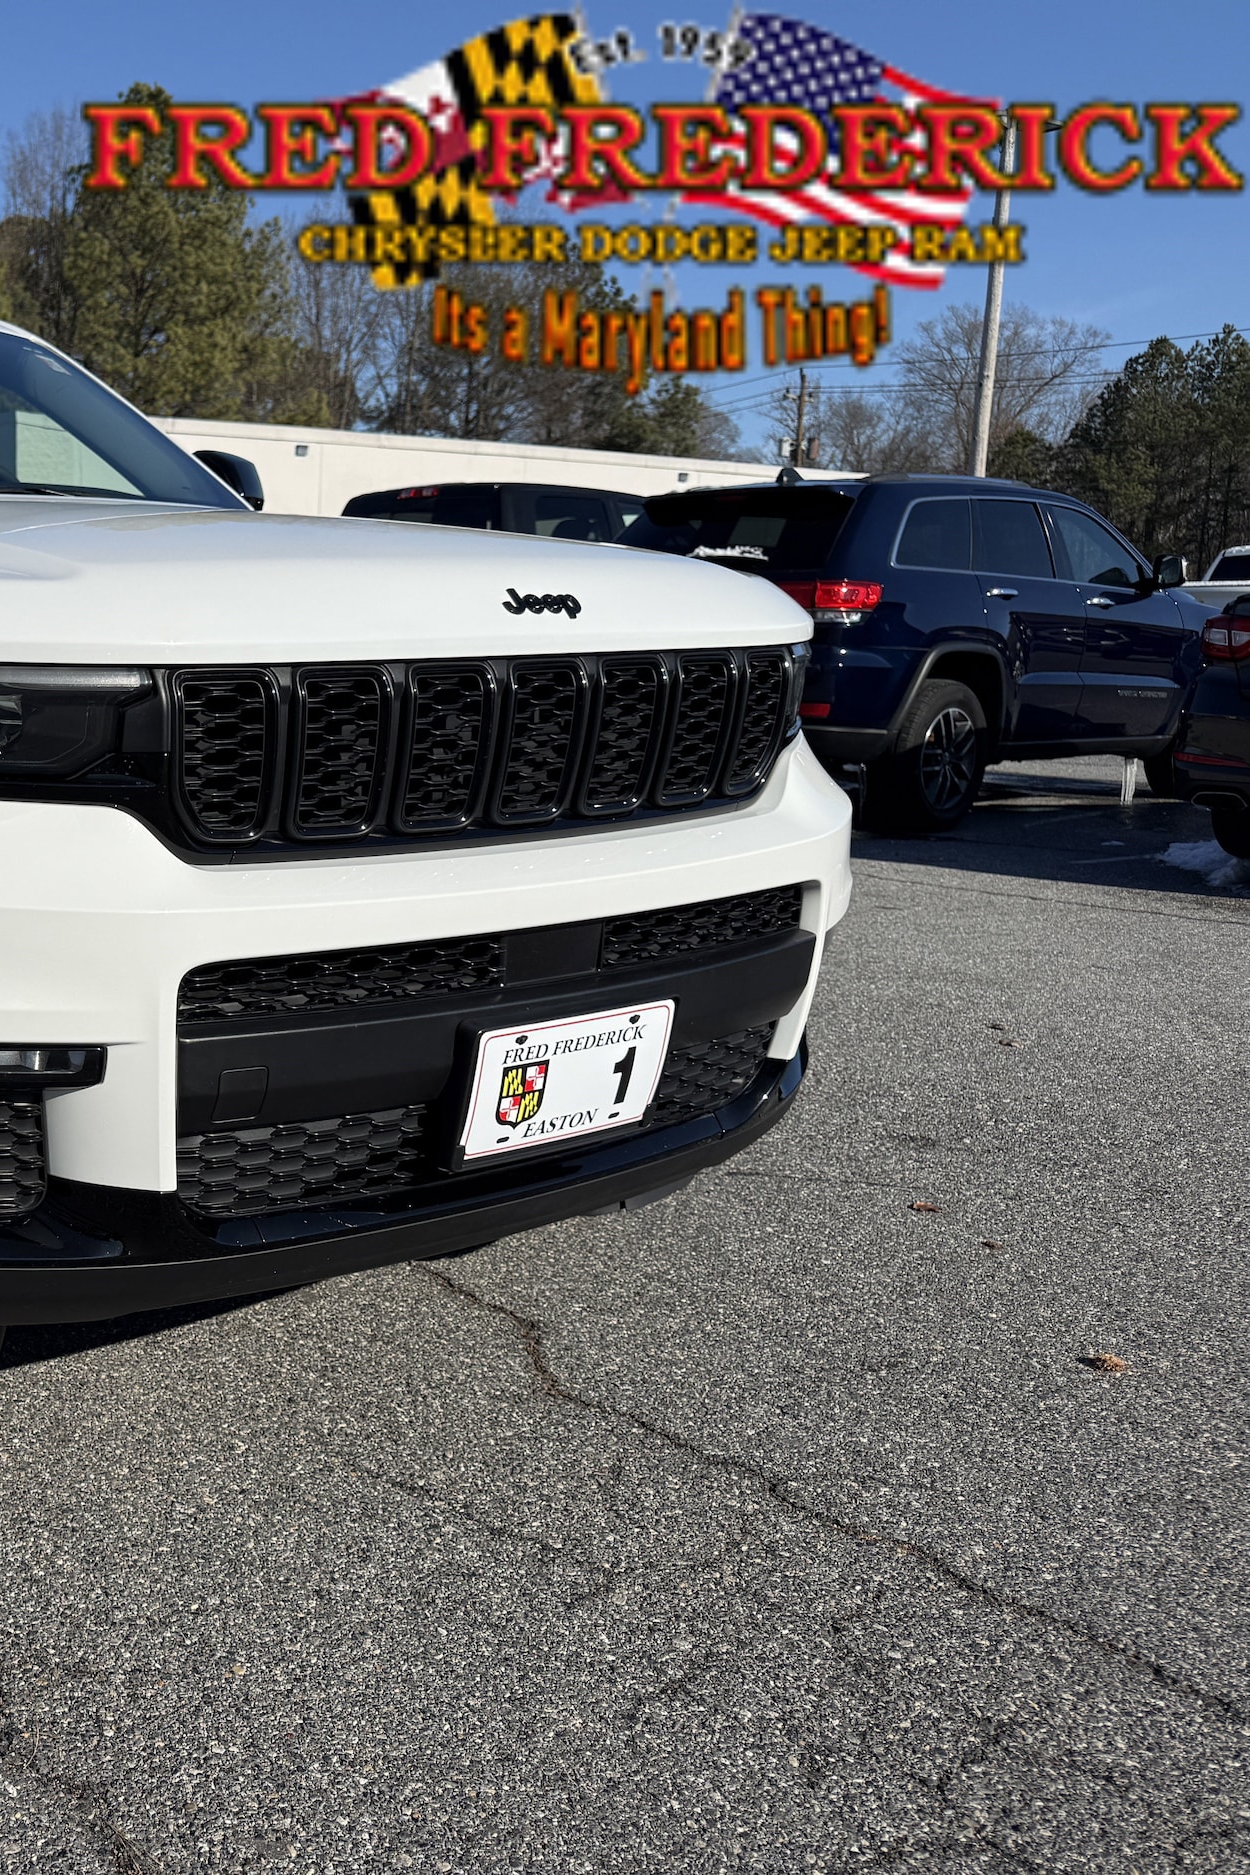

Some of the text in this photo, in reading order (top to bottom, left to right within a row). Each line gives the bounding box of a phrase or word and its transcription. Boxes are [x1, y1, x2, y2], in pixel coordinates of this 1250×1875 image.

[502, 588, 582, 619] Jeep
[502, 1024, 647, 1065] FRED FREDERICK
[613, 1046, 637, 1105] 1
[520, 1108, 601, 1138] EASTON
